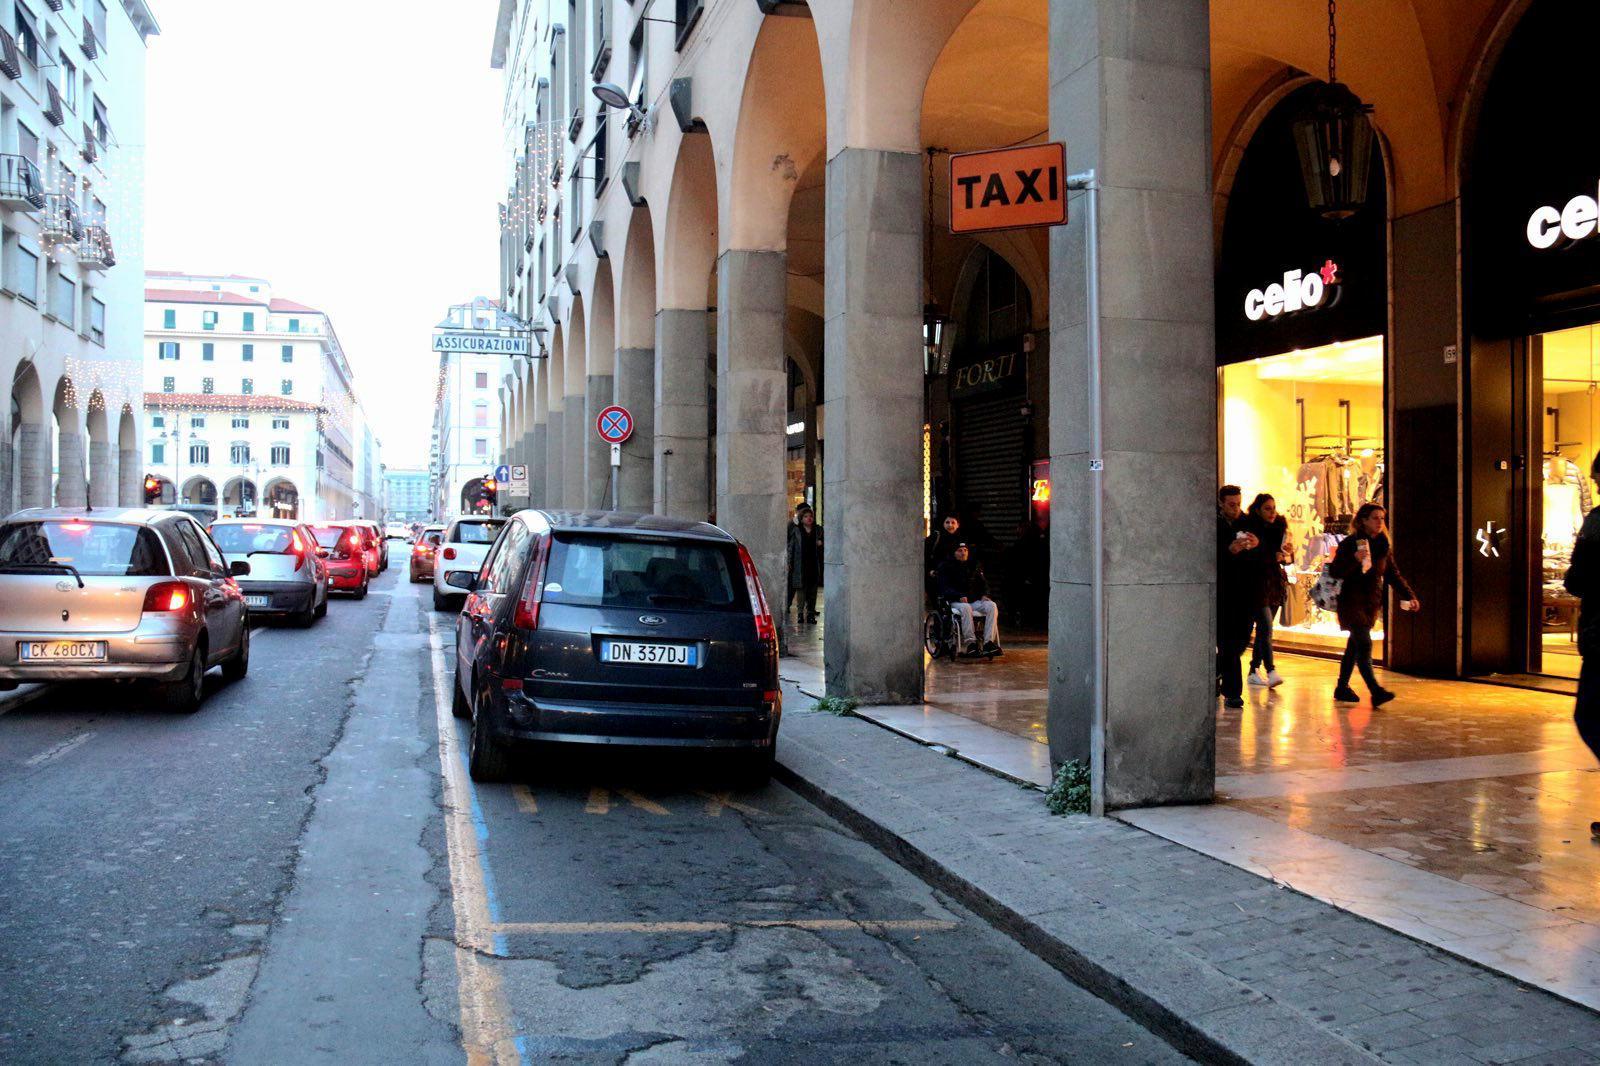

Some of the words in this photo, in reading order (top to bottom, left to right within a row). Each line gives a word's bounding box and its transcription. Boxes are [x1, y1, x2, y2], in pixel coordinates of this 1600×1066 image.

[957, 166, 1058, 210] TAXI
[1527, 179, 1600, 249] ce
[435, 337, 525, 352] ASSICURAZIONI
[954, 353, 1017, 390] FORTI
[31, 644, 48, 657] CK
[53, 643, 95, 657] 480CX
[612, 644, 632, 661] DN
[638, 645, 686, 663] 337DJ
